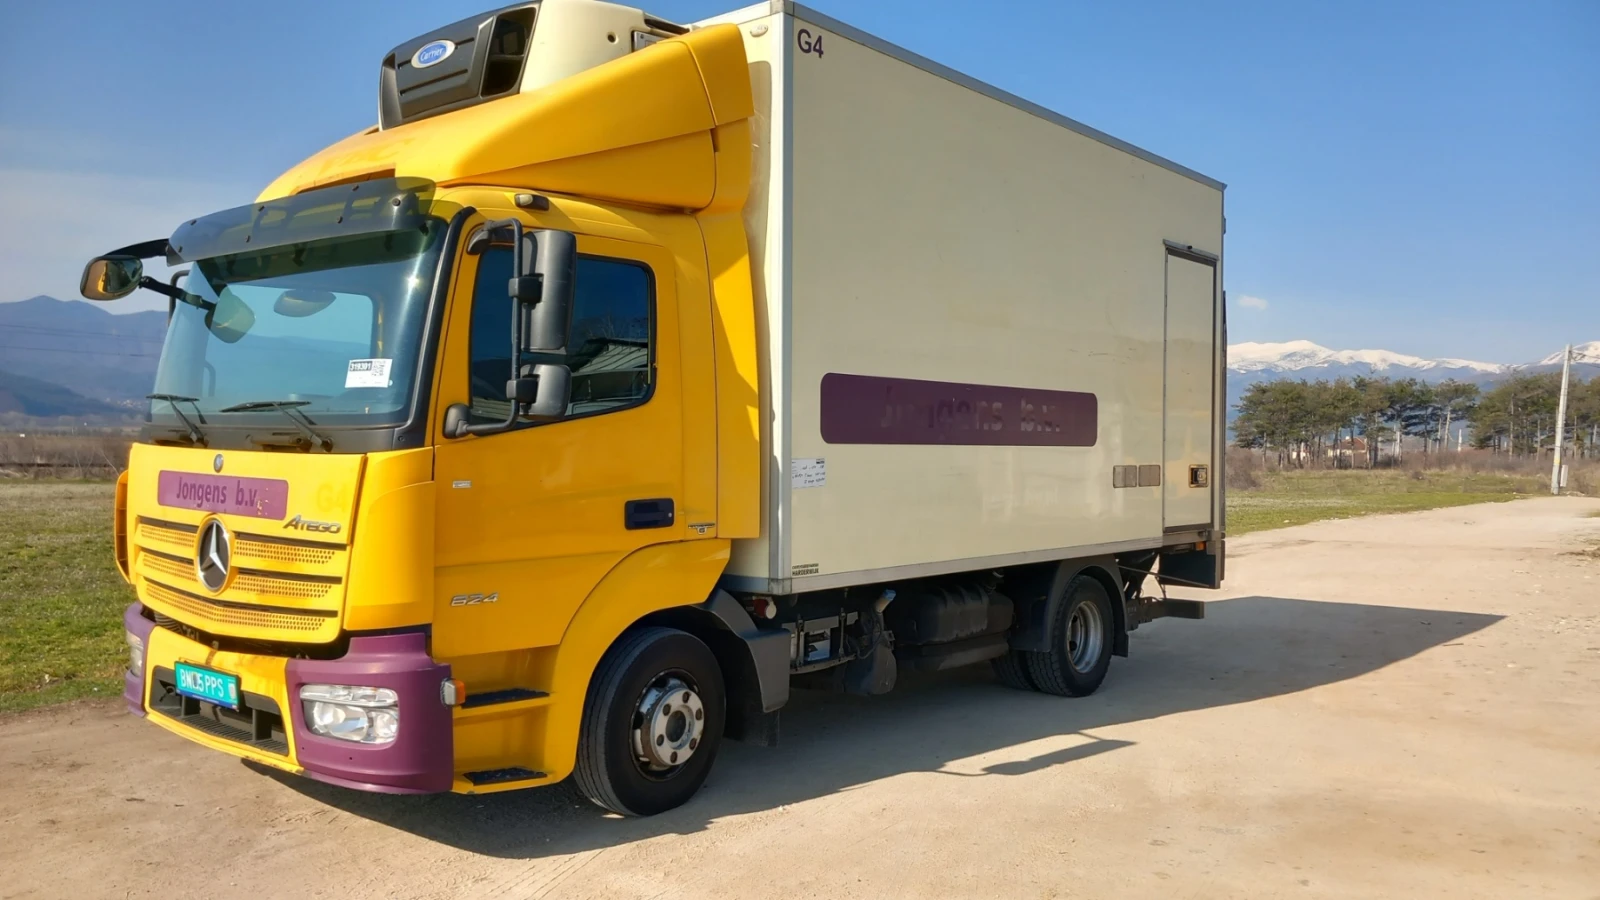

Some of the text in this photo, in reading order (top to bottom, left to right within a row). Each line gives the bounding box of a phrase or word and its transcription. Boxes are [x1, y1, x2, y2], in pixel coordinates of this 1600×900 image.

[420, 47, 444, 62] Carrier
[797, 28, 824, 59] G4
[176, 476, 227, 508] Jongens
